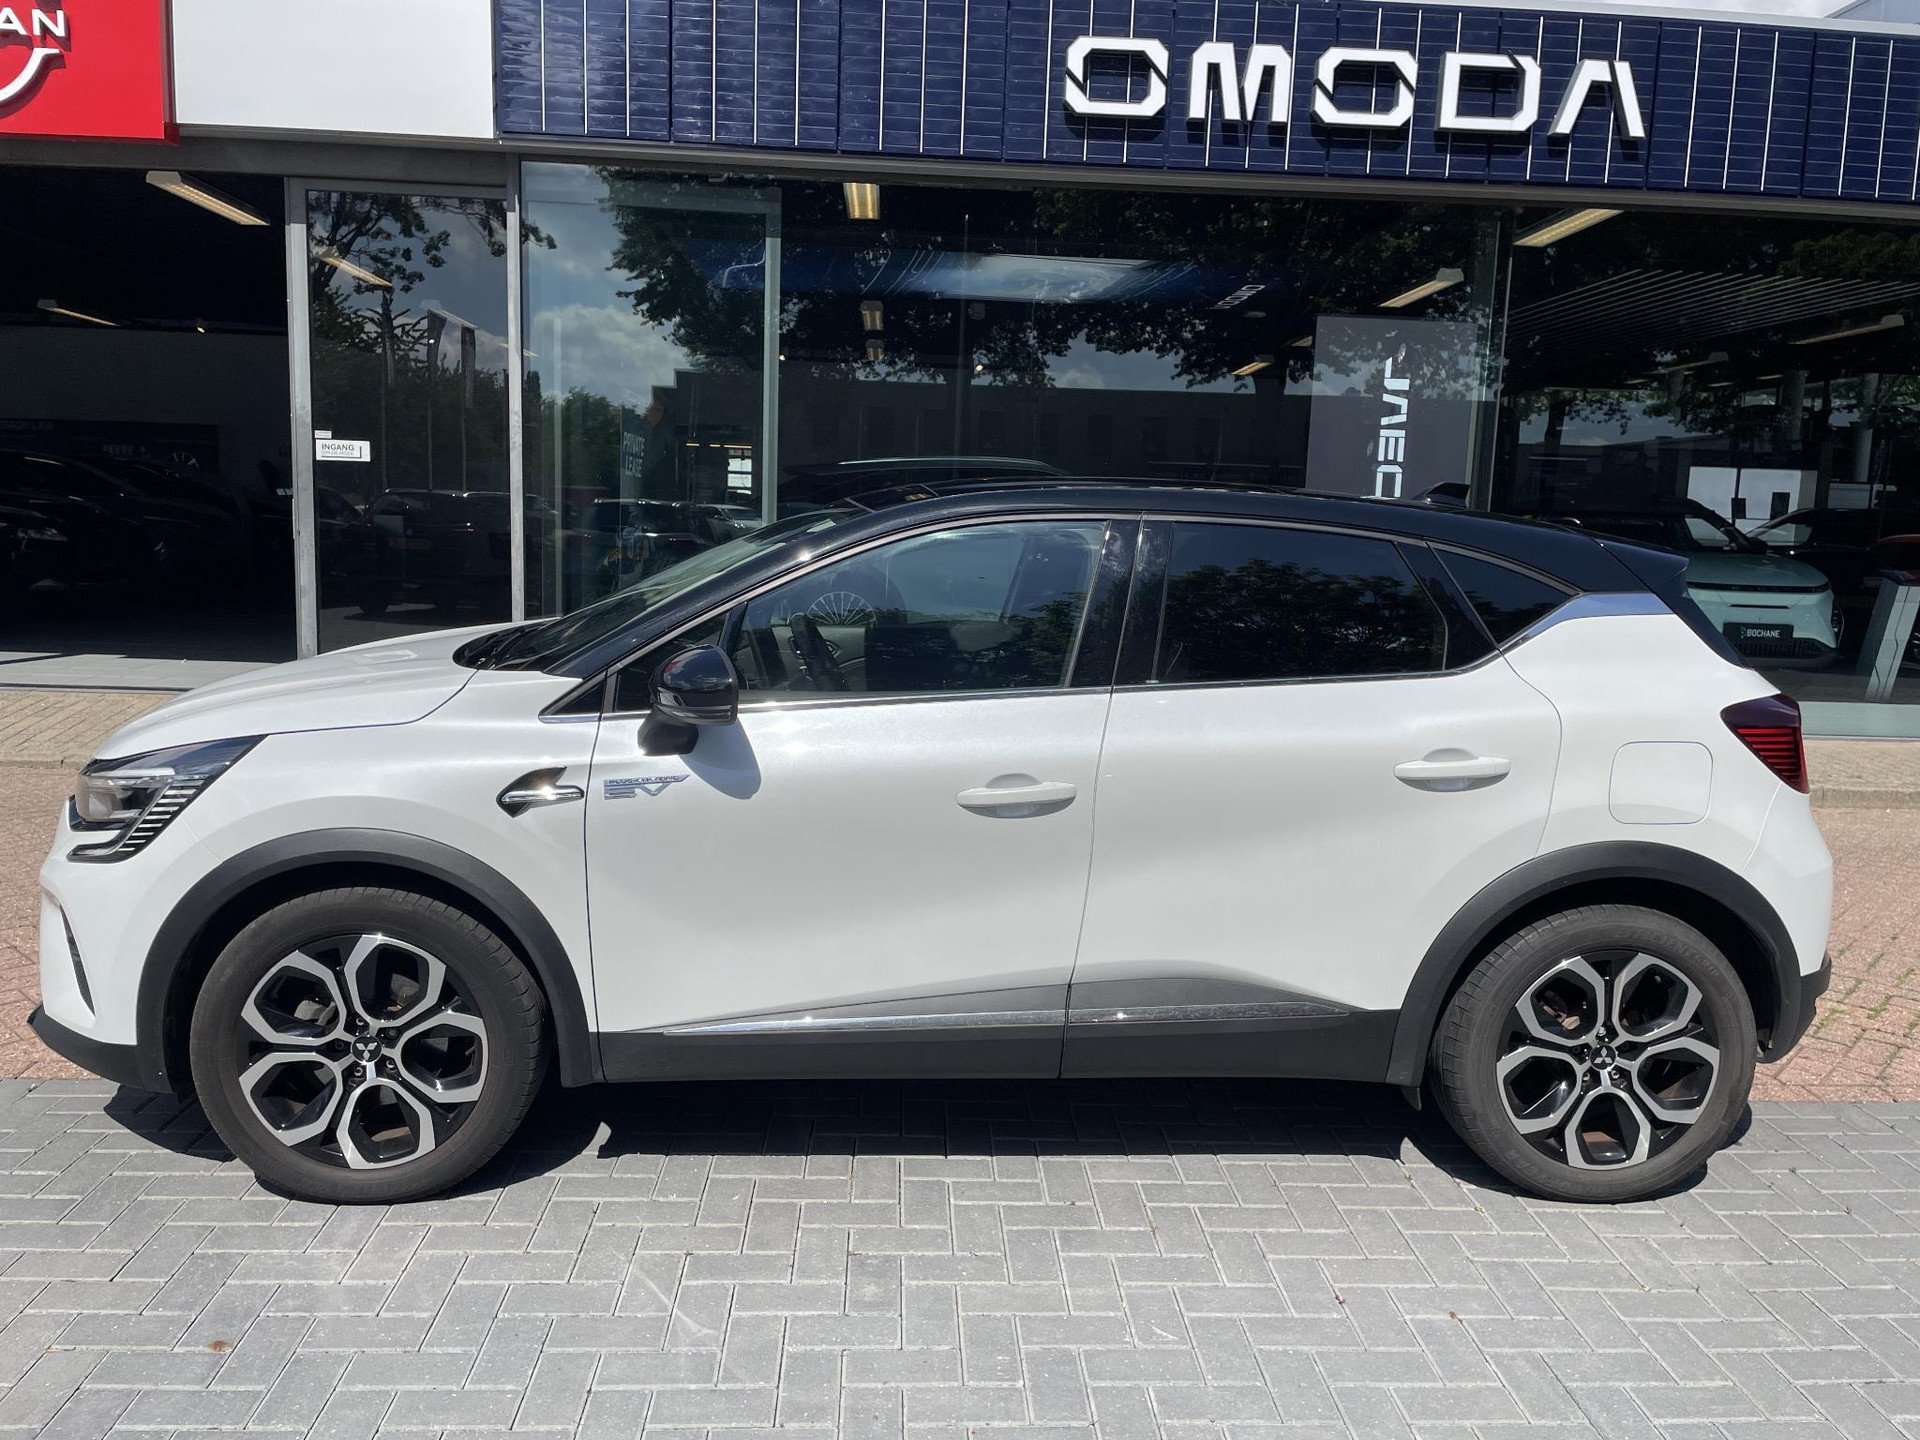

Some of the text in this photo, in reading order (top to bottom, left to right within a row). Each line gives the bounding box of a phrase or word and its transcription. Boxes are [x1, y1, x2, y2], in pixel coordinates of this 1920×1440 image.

[0, 7, 66, 37] AN
[1065, 36, 1646, 139] OMODA
[321, 443, 355, 451] INGANG
[623, 431, 646, 457] PRIVATE
[625, 455, 643, 478] LEASE
[1746, 628, 1781, 638] BOCHANE
